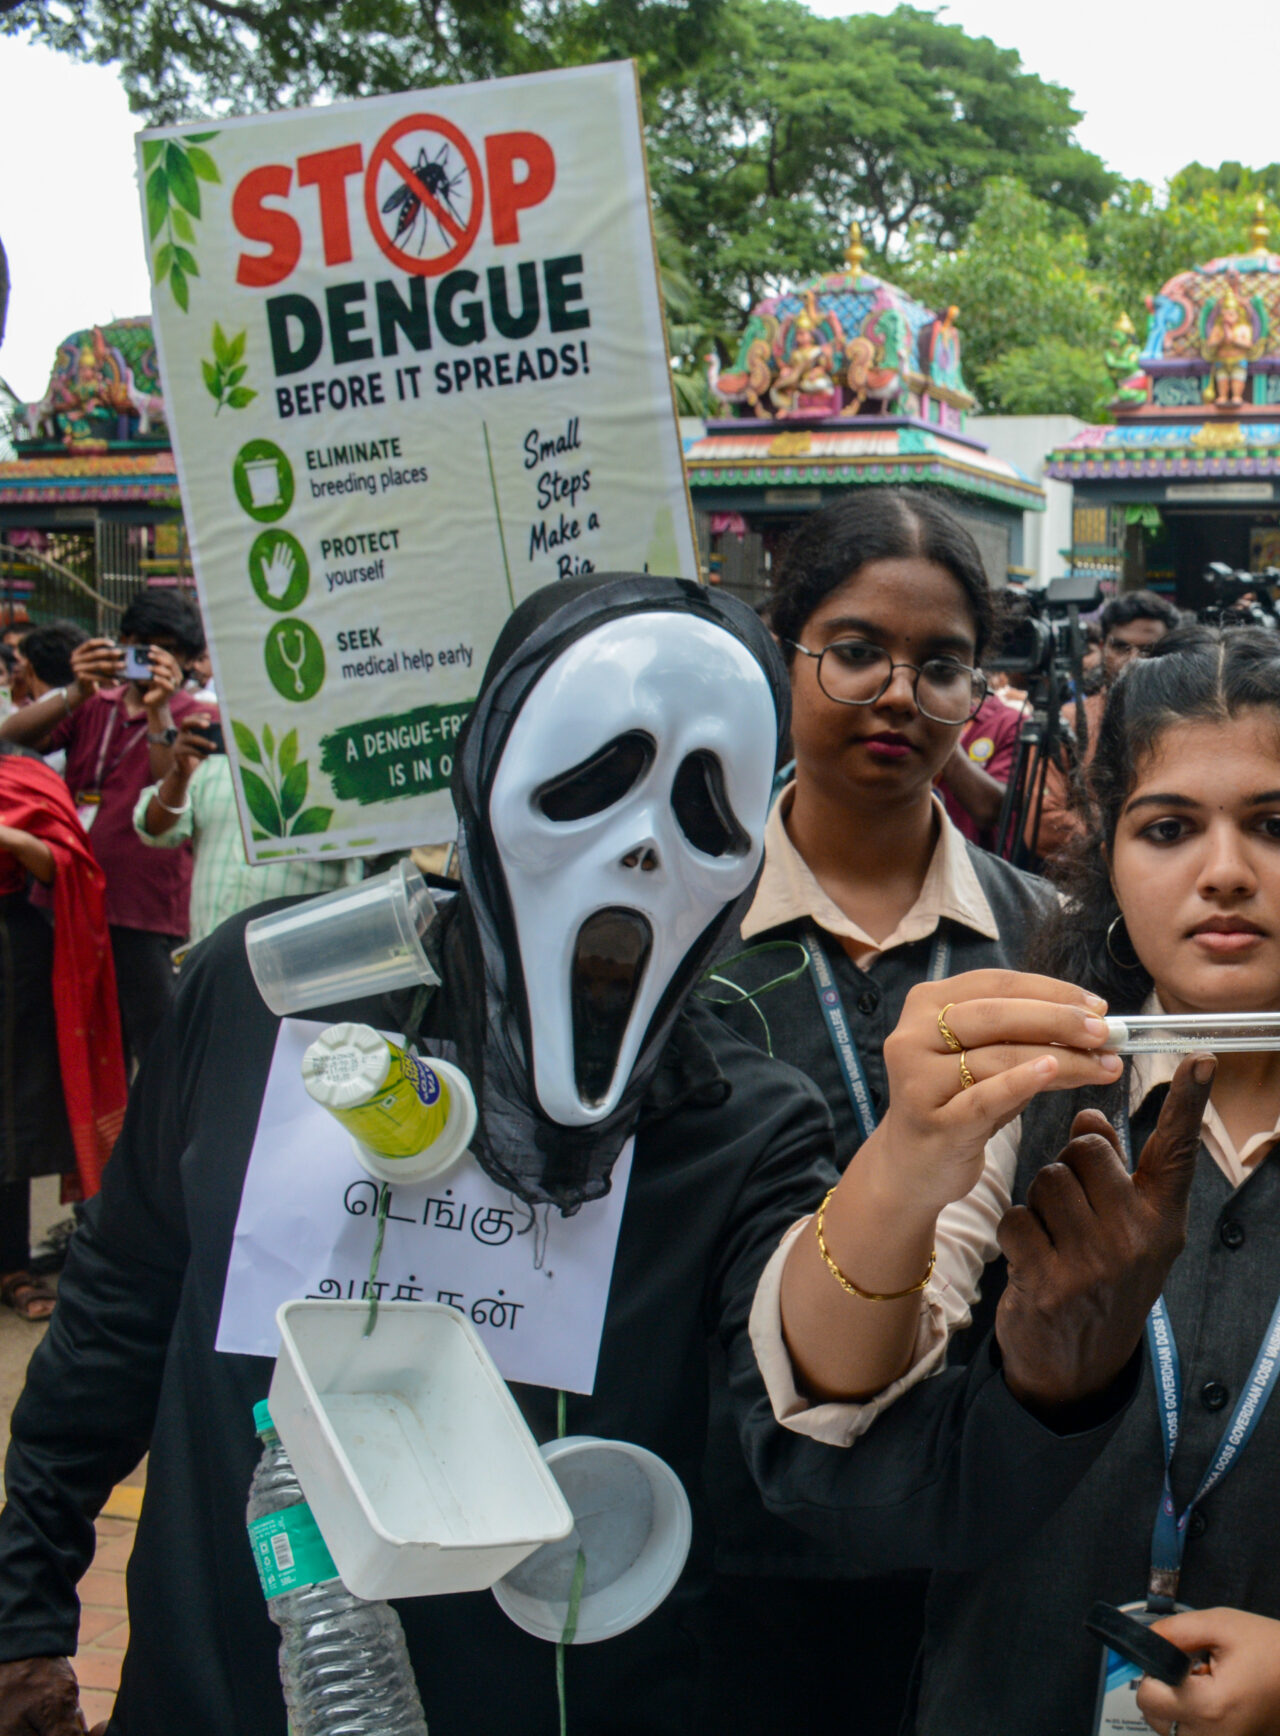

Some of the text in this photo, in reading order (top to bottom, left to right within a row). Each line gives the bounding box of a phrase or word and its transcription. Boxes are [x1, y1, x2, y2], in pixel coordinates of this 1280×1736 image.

[231, 112, 556, 288] STOP
[265, 254, 591, 377] DENGUE
[275, 341, 591, 419] BEFORE IT SPREADS!
[306, 437, 403, 471] ELIMINATE
[524, 416, 582, 469] Small
[310, 466, 429, 499] breeding places
[537, 469, 591, 510] Steps
[320, 529, 400, 560] PROTECT
[529, 512, 601, 562] Make a
[325, 559, 386, 593] yourself
[337, 626, 383, 652] SEEK
[341, 642, 474, 679] medical help early
[345, 737, 360, 763] A
[388, 753, 455, 787] IS IN O
[829, 1007, 849, 1044] COLLEGE
[851, 1080, 867, 1103] DOSS
[343, 1180, 514, 1246] டெங்கு
[1153, 1318, 1169, 1346] DOSS
[1158, 1345, 1177, 1410] GOVERDHAN
[1166, 1411, 1178, 1440] DOSS
[1214, 1444, 1237, 1472] DOSS
[1228, 1385, 1264, 1446] GOVERDHAN
[1253, 1357, 1275, 1387] DOSS
